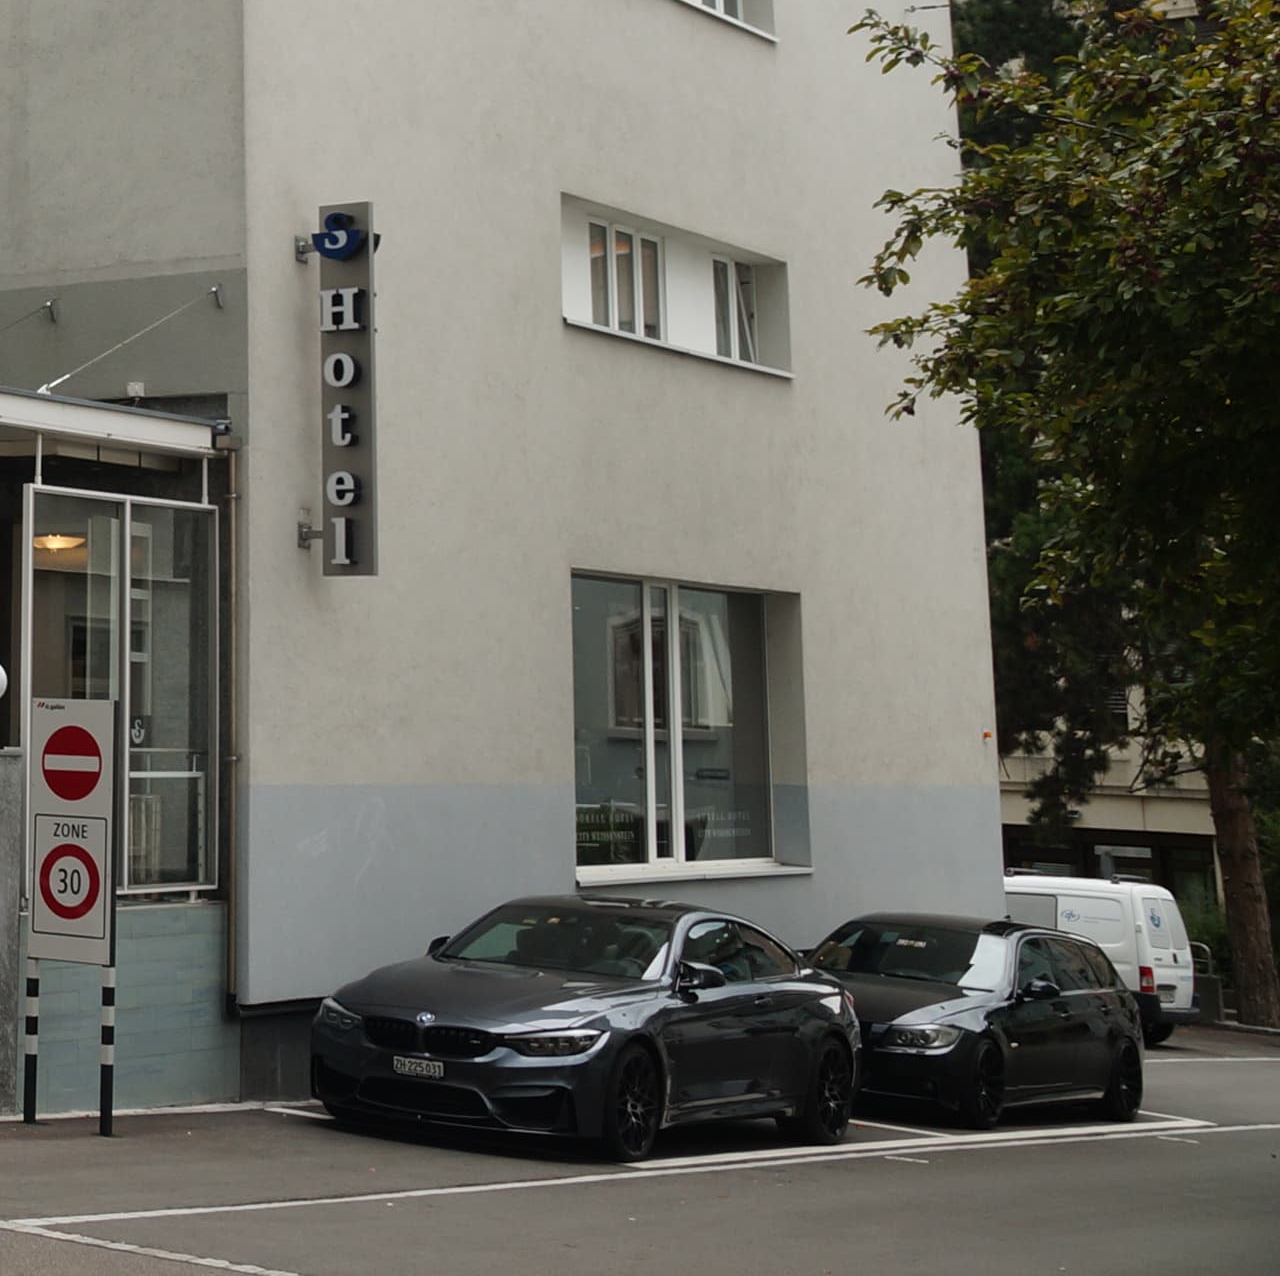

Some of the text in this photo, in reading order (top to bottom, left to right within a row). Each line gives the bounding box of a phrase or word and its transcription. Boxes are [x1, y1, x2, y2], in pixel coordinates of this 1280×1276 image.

[319, 287, 361, 566] Hotel
[53, 823, 88, 839] ZONE
[58, 868, 81, 895] 30
